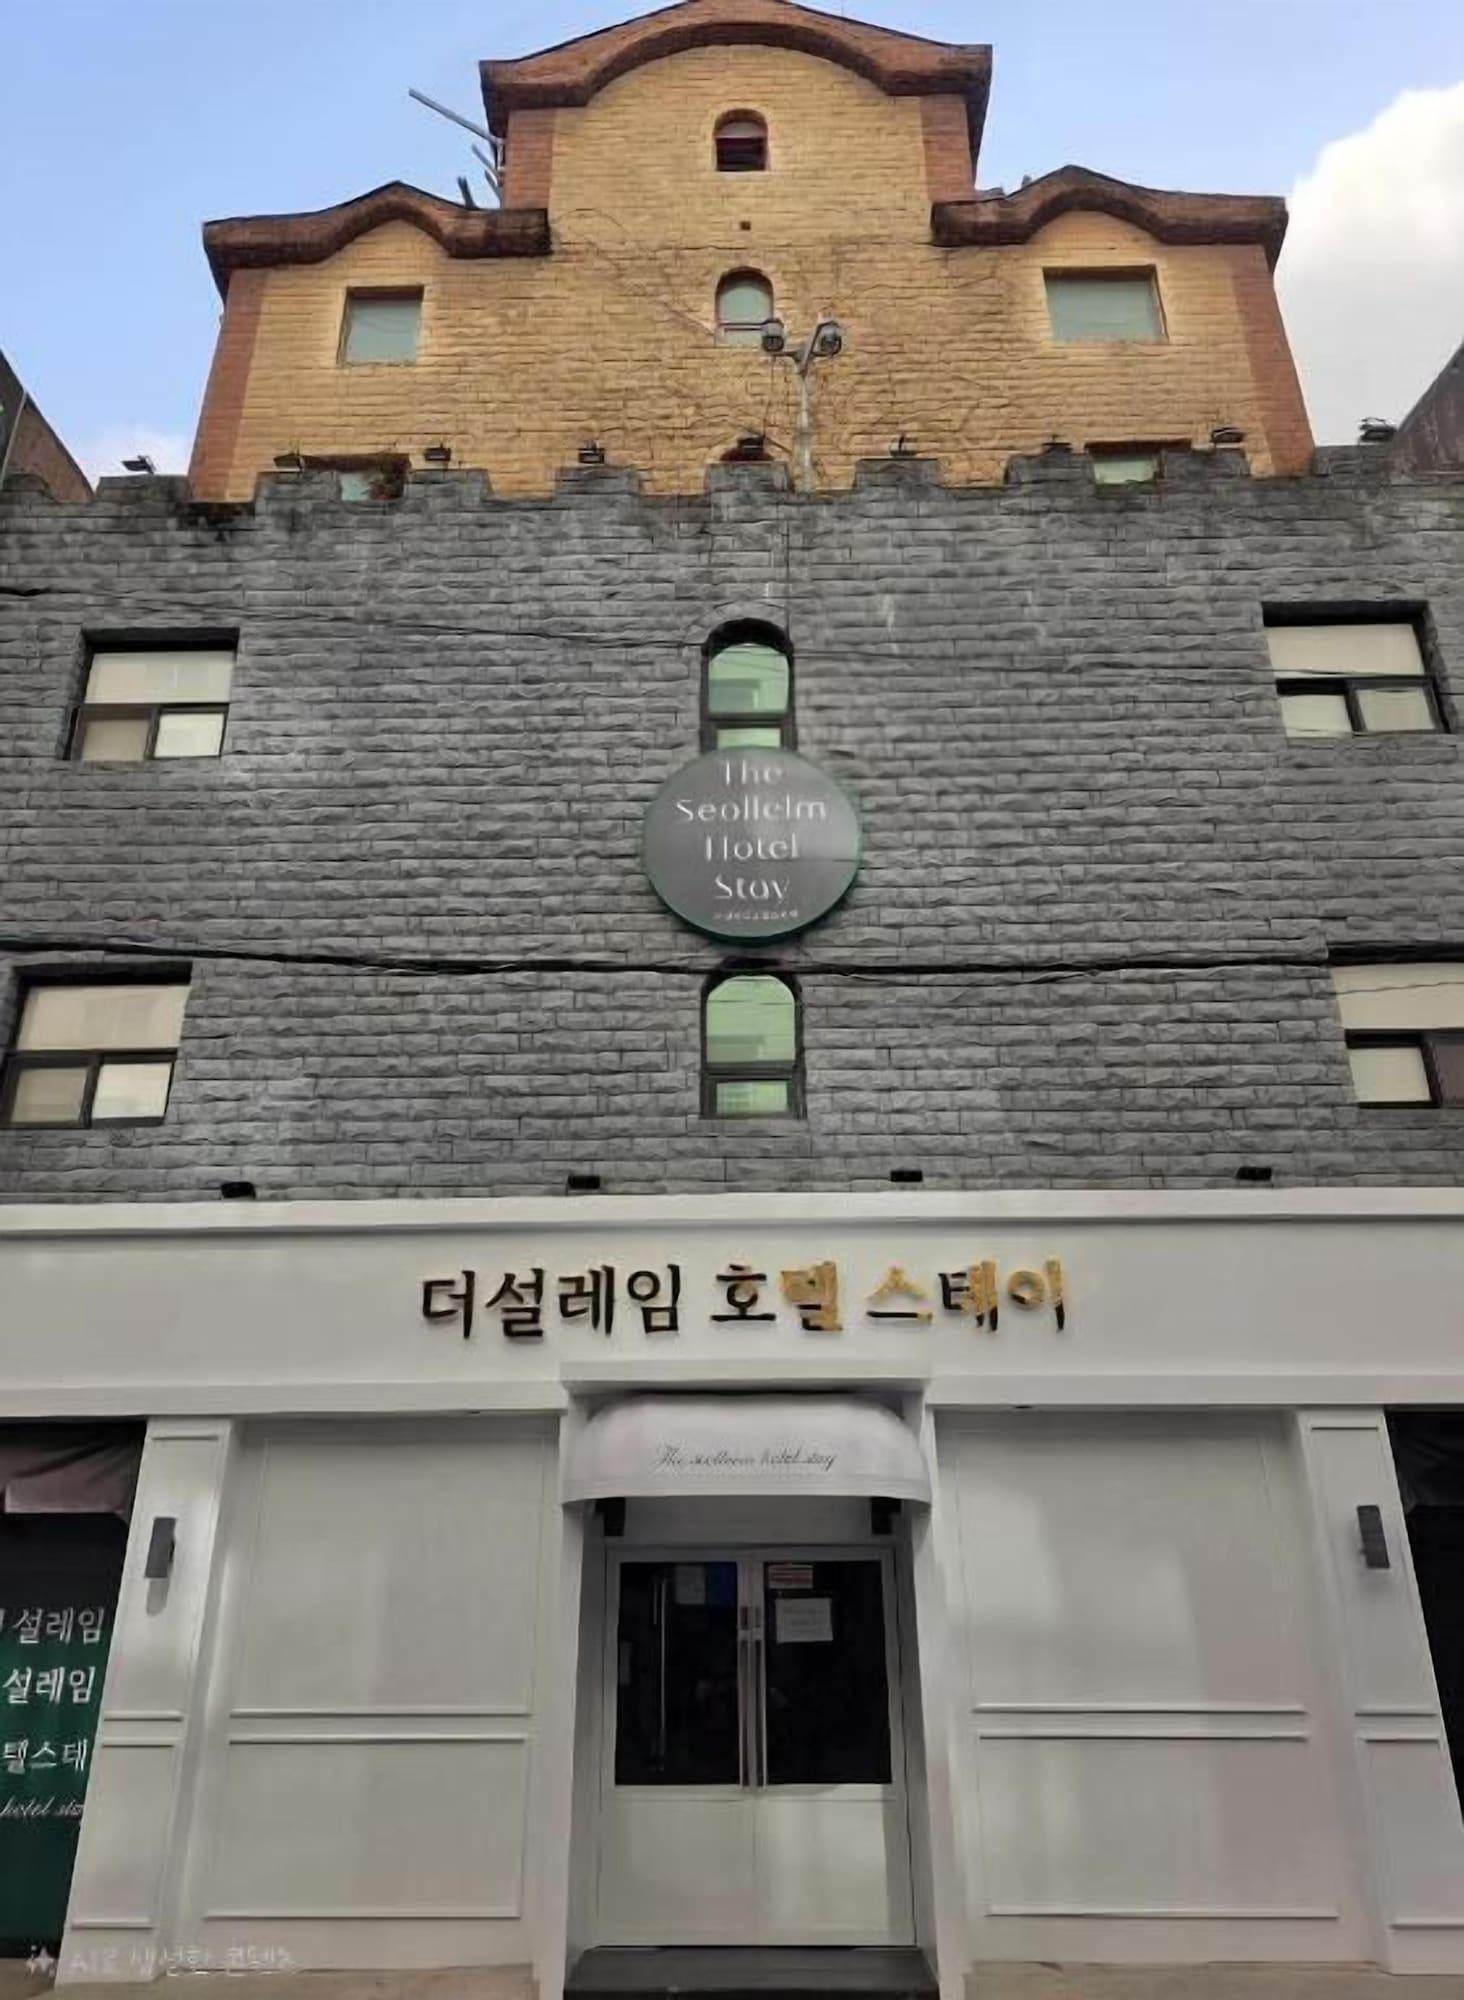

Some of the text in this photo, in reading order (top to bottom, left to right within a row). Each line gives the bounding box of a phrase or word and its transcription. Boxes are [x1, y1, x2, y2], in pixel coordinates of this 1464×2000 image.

[719, 759, 785, 786] The
[705, 832, 799, 862] Hotel
[714, 874, 791, 904] Stay
[422, 1259, 1065, 1340] 더설레임 호텔 스테이
[0, 1607, 105, 1645] 설레임
[2, 1665, 97, 1705] 설레임
